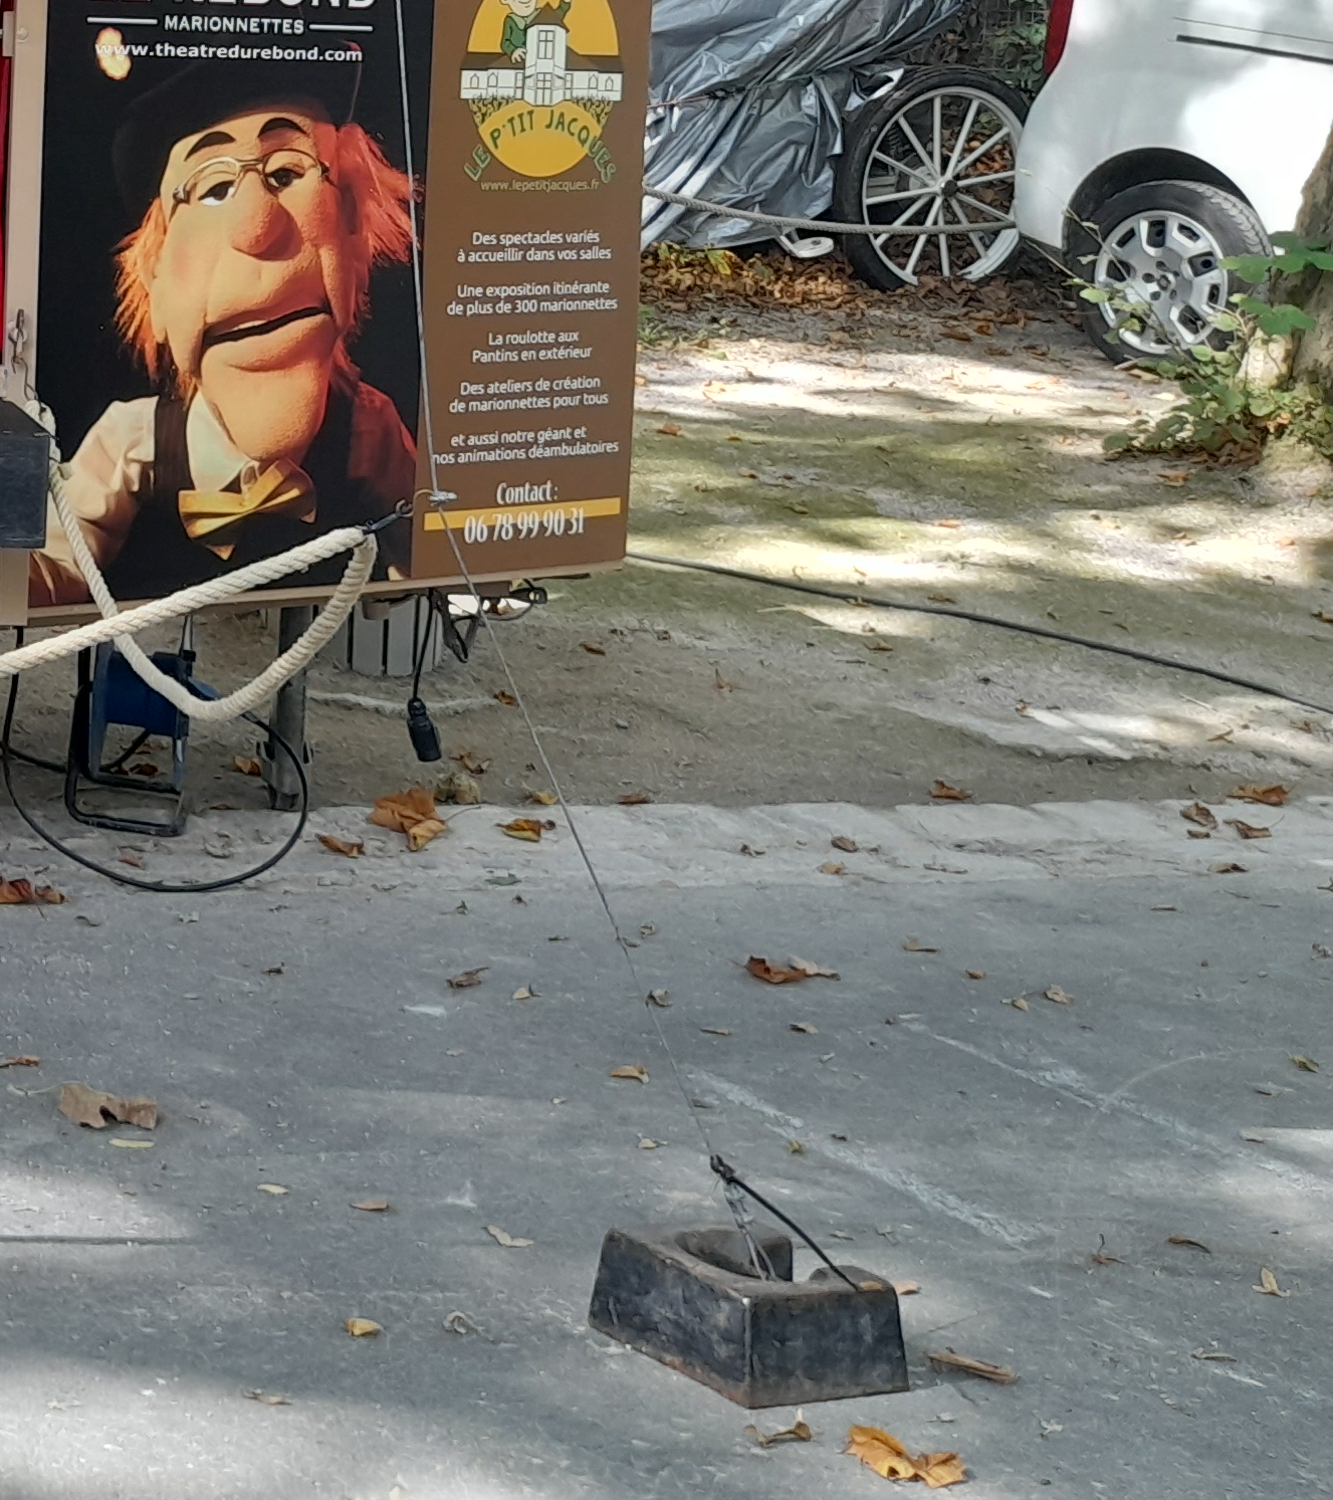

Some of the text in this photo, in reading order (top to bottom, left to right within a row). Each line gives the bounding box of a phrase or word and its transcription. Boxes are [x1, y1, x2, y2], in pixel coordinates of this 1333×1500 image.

[164, 15, 305, 35] MARIONNETTES
[95, 42, 363, 62] www.theatredurebond.com
[463, 144, 492, 182] LE
[545, 109, 617, 184] JACQUES
[472, 229, 601, 247] Des spectacles variés
[457, 246, 612, 263] à accueillir dans vos salles
[457, 280, 610, 299] Une exposition itinérante
[446, 298, 618, 317] de plus de 300 marionnettes
[488, 330, 579, 346] La roulotte aux
[472, 346, 593, 363] Pantins en extérieur
[460, 375, 601, 396] Des ateliers de création
[449, 392, 609, 413] de marionnettes pour tous
[450, 426, 587, 447] et aussi notre géant et
[433, 441, 620, 465] nos animations déambulatoires
[463, 506, 584, 544] 06 78 99 90 31
